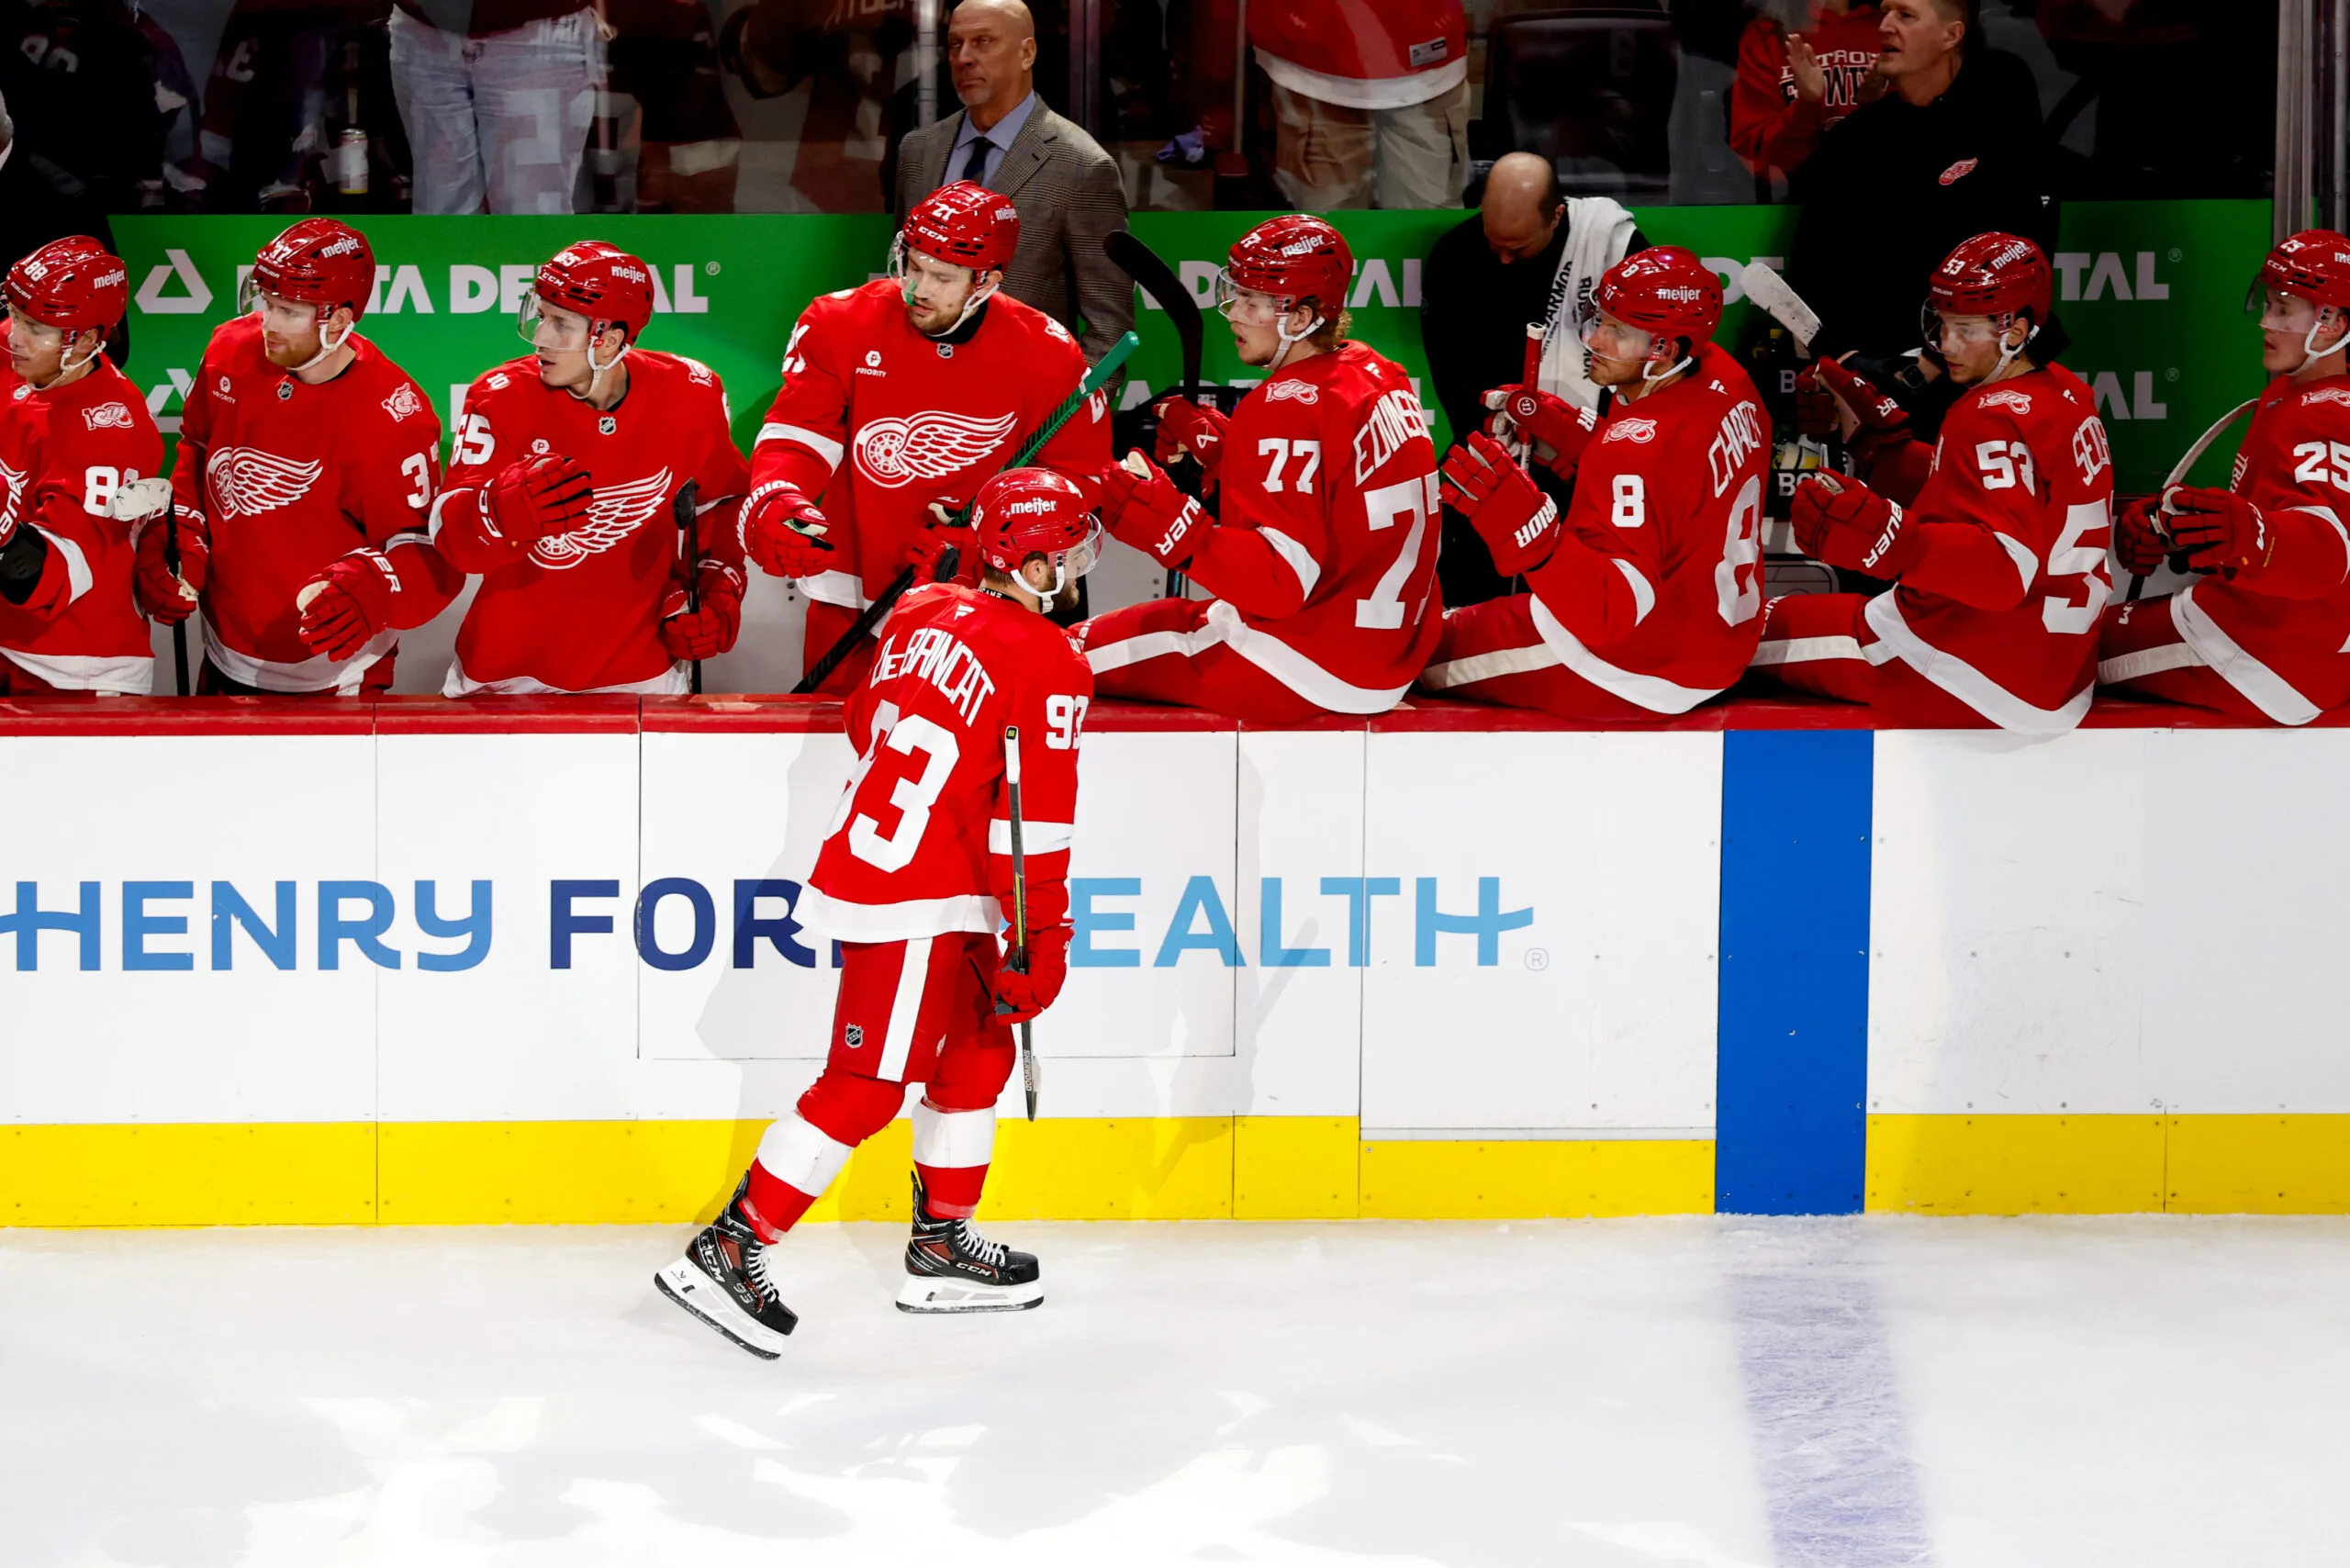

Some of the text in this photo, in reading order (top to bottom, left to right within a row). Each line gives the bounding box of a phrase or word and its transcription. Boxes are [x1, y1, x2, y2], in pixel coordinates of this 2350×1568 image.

[918, 226, 949, 242] CCM
[321, 238, 361, 259] meijer
[1281, 234, 1325, 258] meijer
[1991, 241, 2031, 270] meijer
[24, 260, 49, 282] 88
[611, 265, 646, 285] meijer
[1621, 263, 1639, 278] 8
[1942, 258, 1966, 275] 53
[2266, 259, 2288, 273] CCM
[94, 269, 126, 289] meijer
[542, 271, 565, 287] CCM
[1656, 286, 1701, 304] meijer
[856, 367, 887, 378] PRIORITY
[1258, 438, 1321, 494] 77
[1010, 497, 1057, 516] meijer
[1612, 475, 1645, 528] 8
[0, 876, 1535, 972] HENRY FOR EALTH
[1024, 1049, 1034, 1092] SHERWOOD
[956, 1261, 993, 1278] CCM
